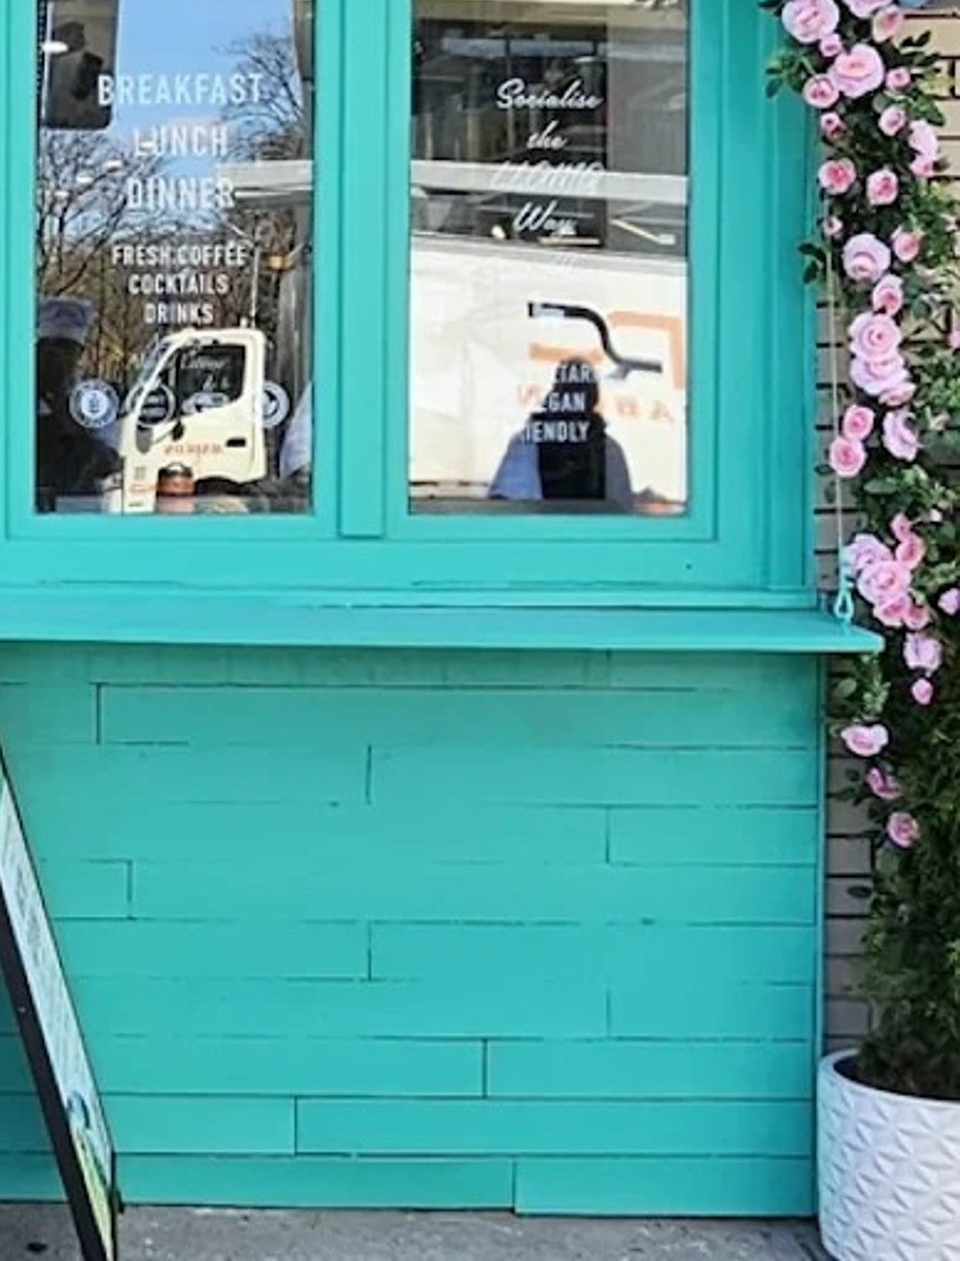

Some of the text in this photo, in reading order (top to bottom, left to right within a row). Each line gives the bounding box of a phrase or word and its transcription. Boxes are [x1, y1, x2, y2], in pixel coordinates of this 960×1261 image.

[97, 73, 265, 106] BREAKFAST
[496, 77, 604, 110] Socialise
[134, 124, 229, 156] LUNCH
[526, 119, 568, 150] the
[127, 175, 235, 209] DINNER
[112, 243, 248, 266] FRESH COFFEE
[128, 273, 230, 295] COCKTAILS
[144, 303, 215, 325] DRINKS
